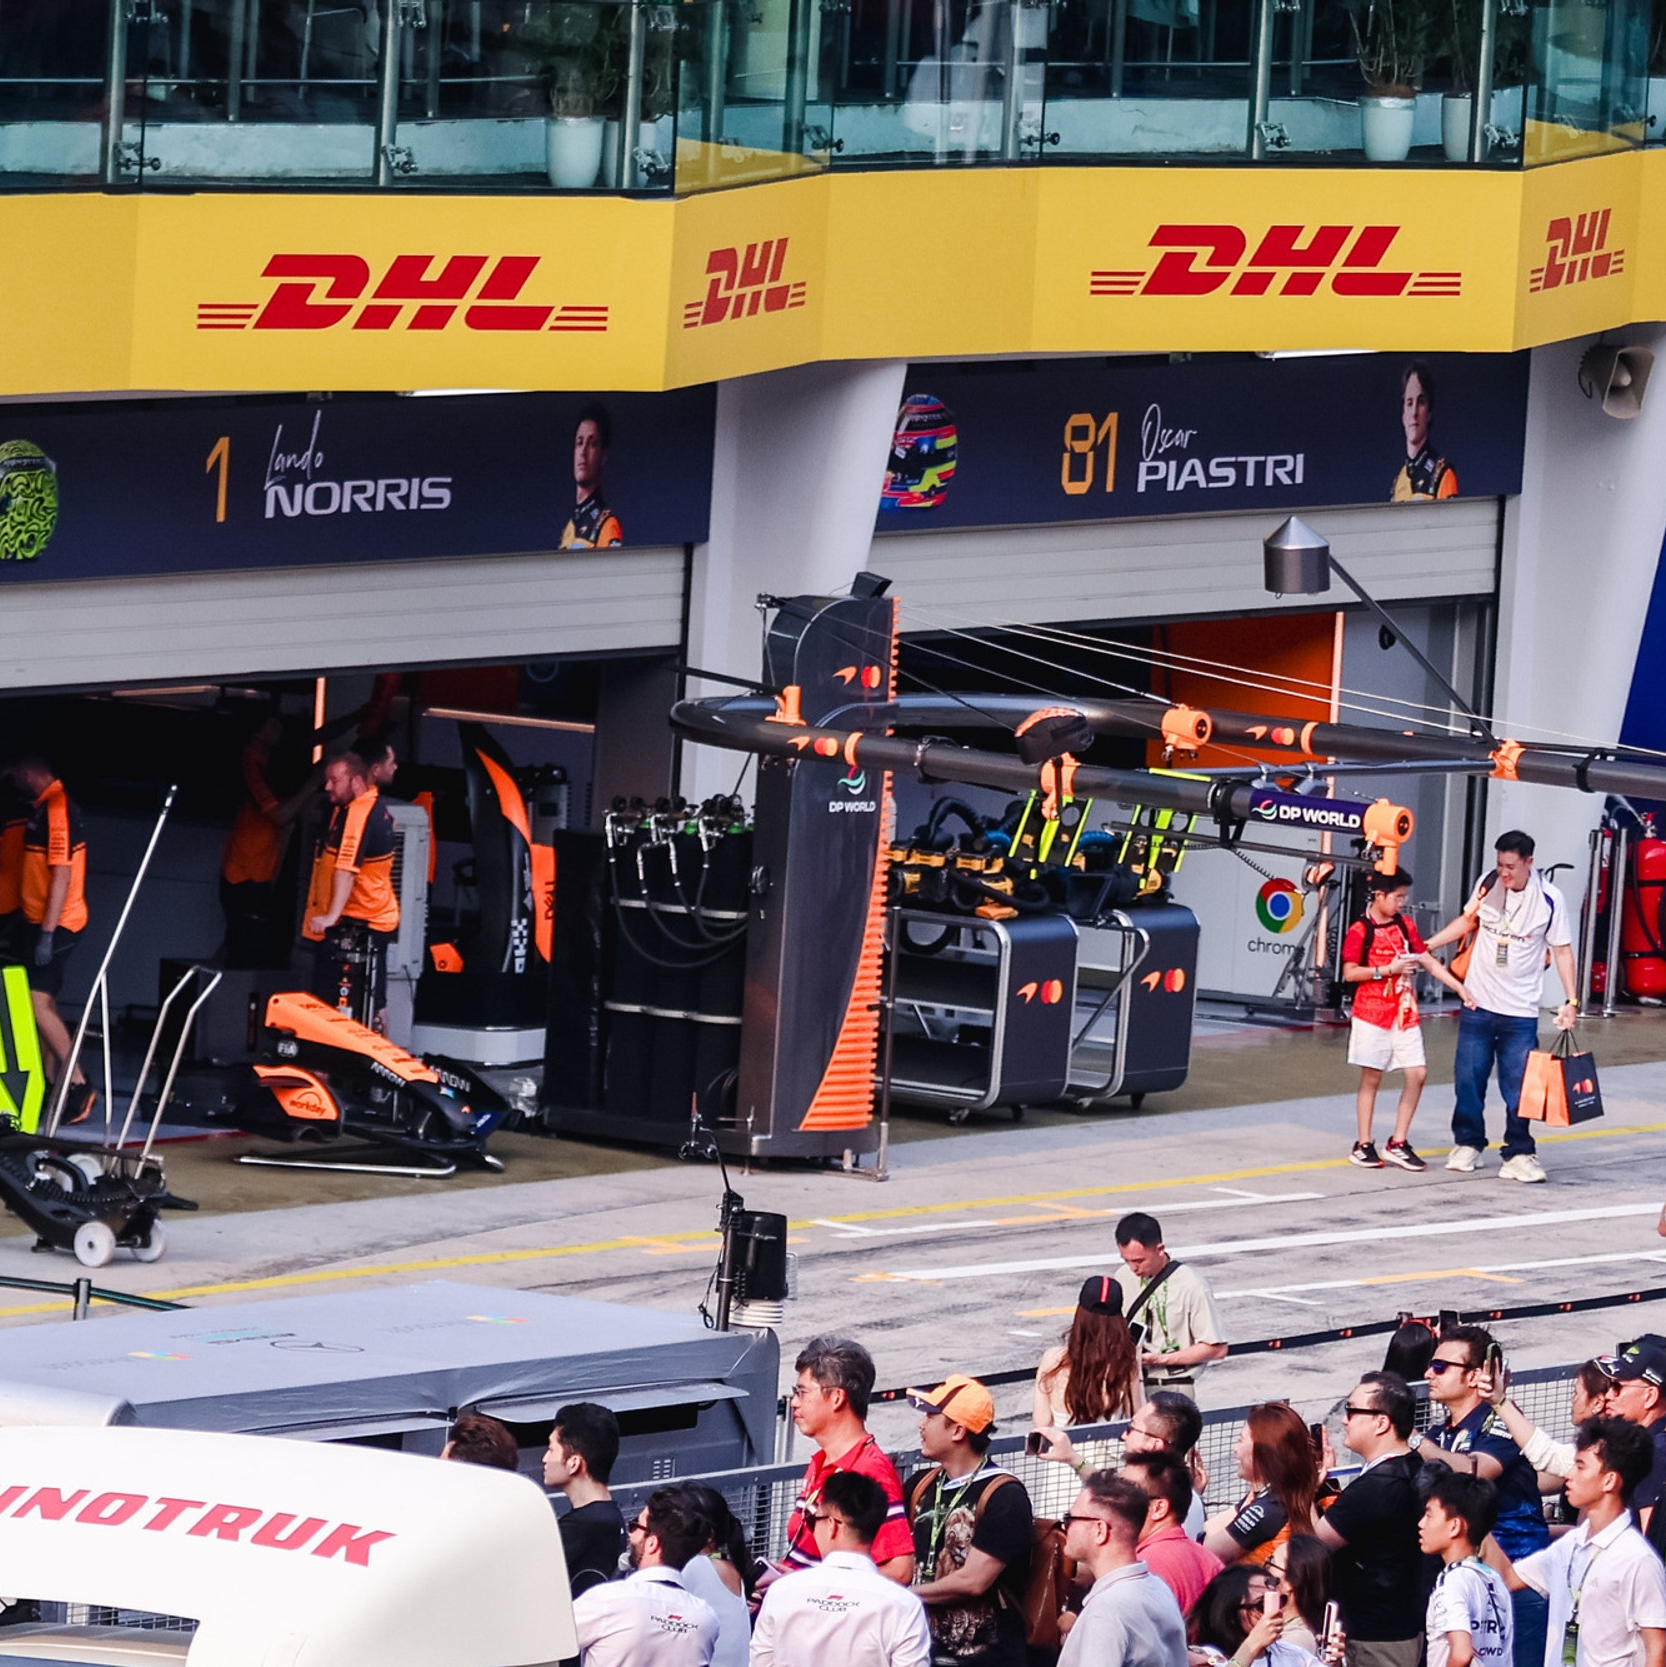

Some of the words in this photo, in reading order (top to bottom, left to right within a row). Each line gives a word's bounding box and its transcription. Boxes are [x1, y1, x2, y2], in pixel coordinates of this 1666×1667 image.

[1141, 225, 1415, 296] DHL
[1542, 208, 1613, 289] DHL
[252, 254, 556, 330] DHL
[700, 237, 792, 325] DHL
[265, 410, 324, 490] Lando
[1062, 412, 1118, 494] 81
[1141, 403, 1197, 461] Oscar
[206, 437, 230, 522] 1
[265, 477, 452, 518] NORRIS
[1137, 453, 1304, 492] PIASTRI
[828, 801, 843, 813] DP
[844, 801, 876, 813] WORLD
[1279, 805, 1301, 821] DP
[1303, 809, 1360, 829] WORLD
[1247, 937, 1297, 955] chrom
[289, 1098, 326, 1116] workday
